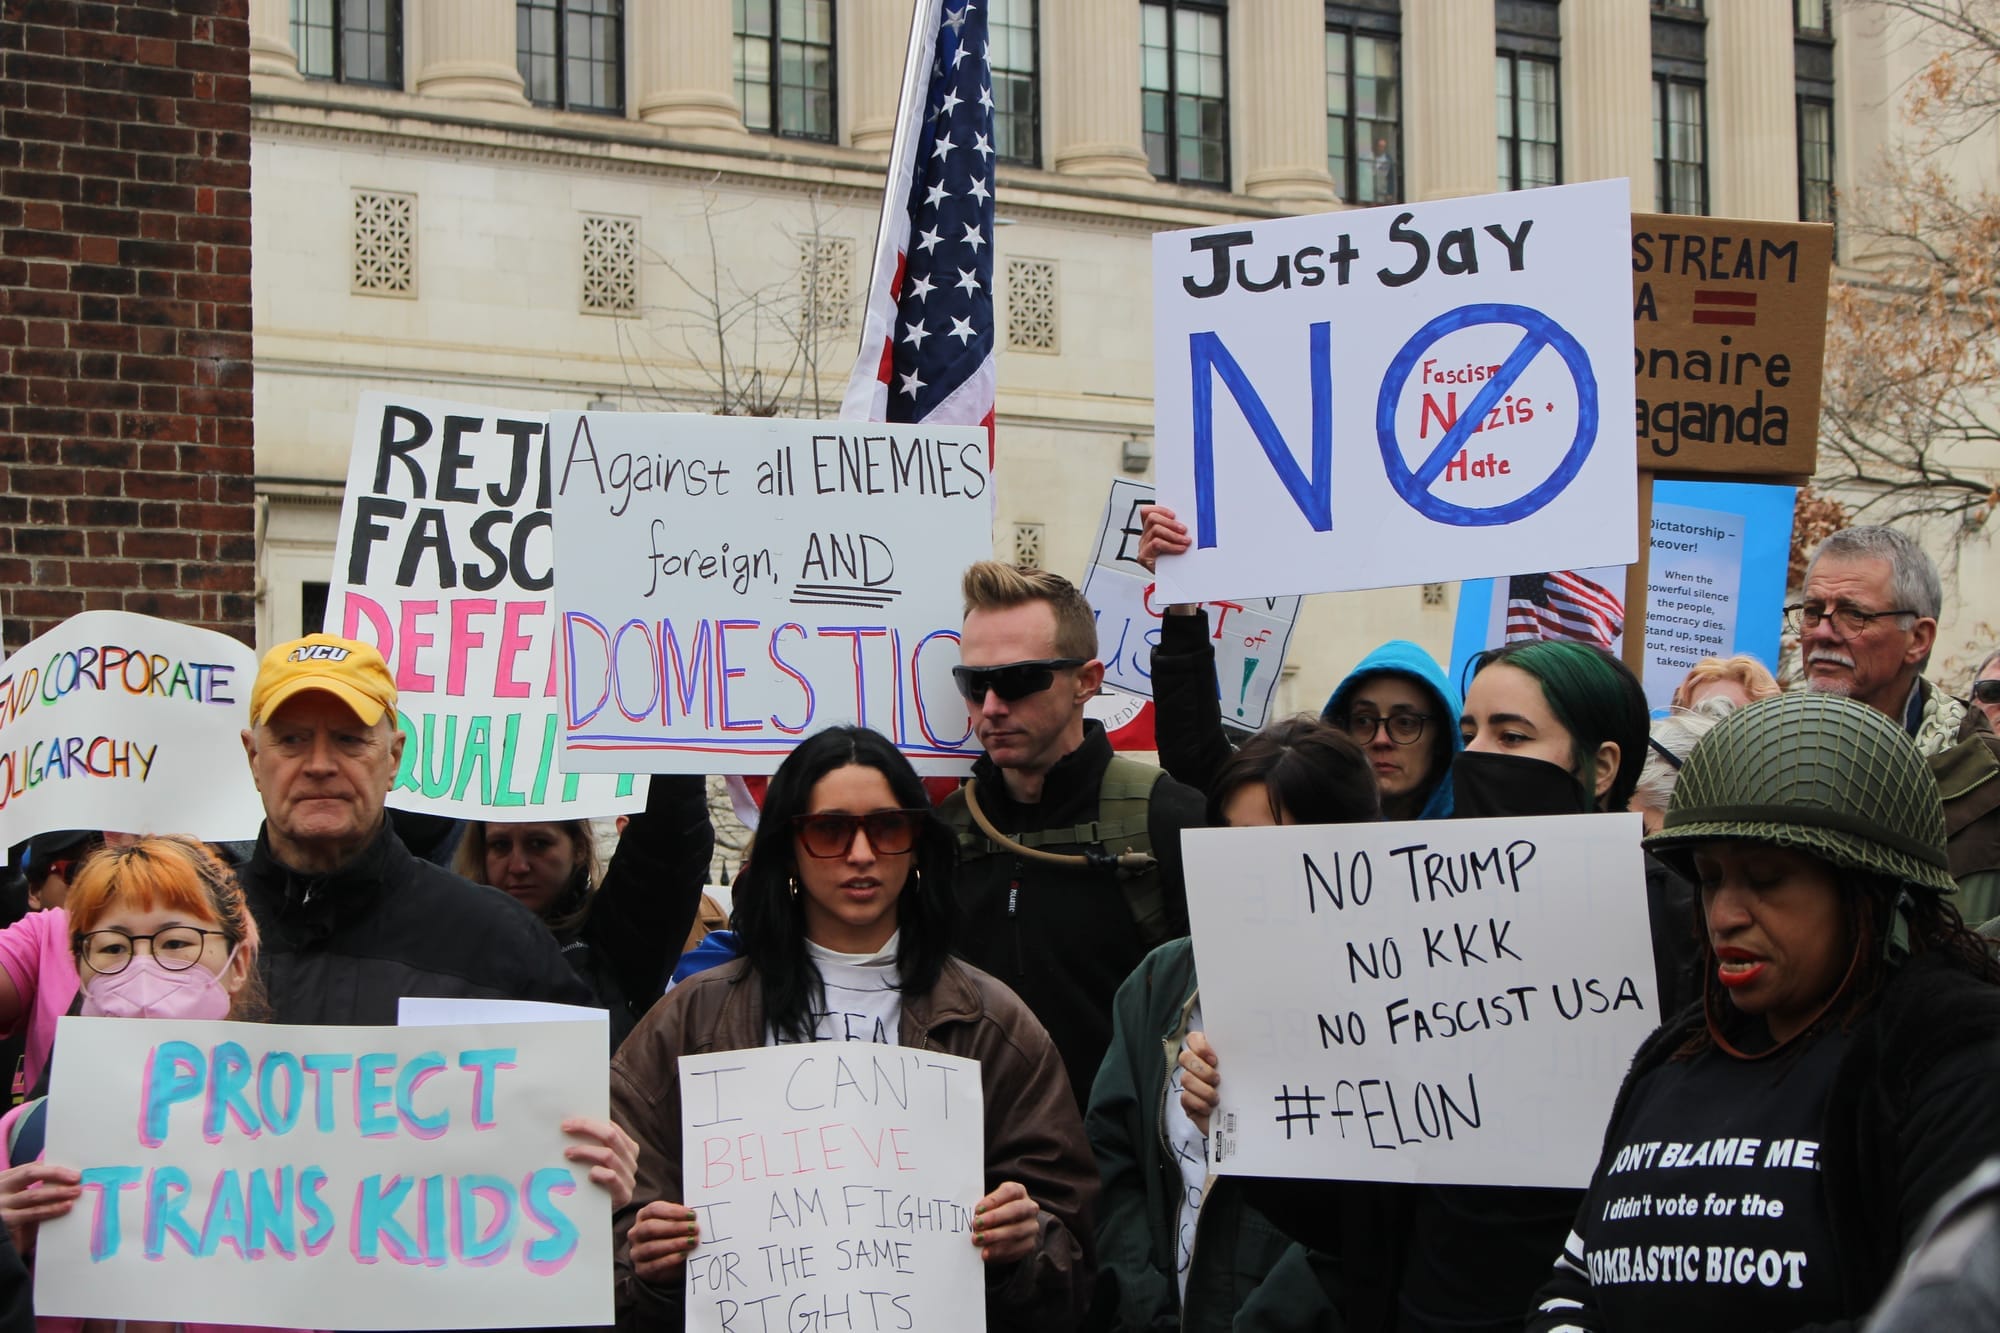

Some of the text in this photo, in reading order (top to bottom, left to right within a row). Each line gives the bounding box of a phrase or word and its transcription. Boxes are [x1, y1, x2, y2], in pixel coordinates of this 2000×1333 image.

[1182, 230, 1359, 298] Just
[1632, 232, 1798, 283] STREAM
[1189, 303, 1599, 549] NO
[1420, 392, 1534, 439] Nzis
[558, 415, 986, 516] Against all ENEMIES
[1446, 449, 1511, 482] Hate
[802, 532, 895, 587] AND
[1665, 570, 1713, 585] When the
[1657, 599, 1674, 608] the
[1694, 589, 1729, 602] silence
[288, 645, 351, 662] VCU
[1670, 645, 1698, 655] resist
[1701, 648, 1717, 657] the
[1694, 634, 1723, 645] speak
[41, 645, 235, 706] CORPORATE
[563, 611, 973, 749] DOMESTIC
[390, 713, 634, 807] QUALI
[1303, 850, 1372, 914] NO
[1389, 840, 1536, 902] TRUMP
[1346, 918, 1522, 984] NO KKK
[1317, 1011, 1365, 1049] NO
[1386, 986, 1537, 1044] FASCIST
[1552, 976, 1643, 1020] USA
[138, 1040, 517, 1149] PROTECT
[690, 1055, 958, 1127] I CAN'T
[702, 1123, 917, 1189] BELIEVE
[1658, 1138, 1761, 1168] BLAME
[81, 1164, 580, 1276] TRANS KIDS
[689, 1201, 732, 1245] I
[769, 1188, 828, 1233] AM
[1610, 1194, 1651, 1220] didn't
[1656, 1194, 1698, 1216] vote
[1704, 1193, 1736, 1216] for
[1741, 1194, 1784, 1218] the
[689, 1240, 914, 1294] FOR THE SAME
[1706, 1247, 1806, 1289] BIGOT
